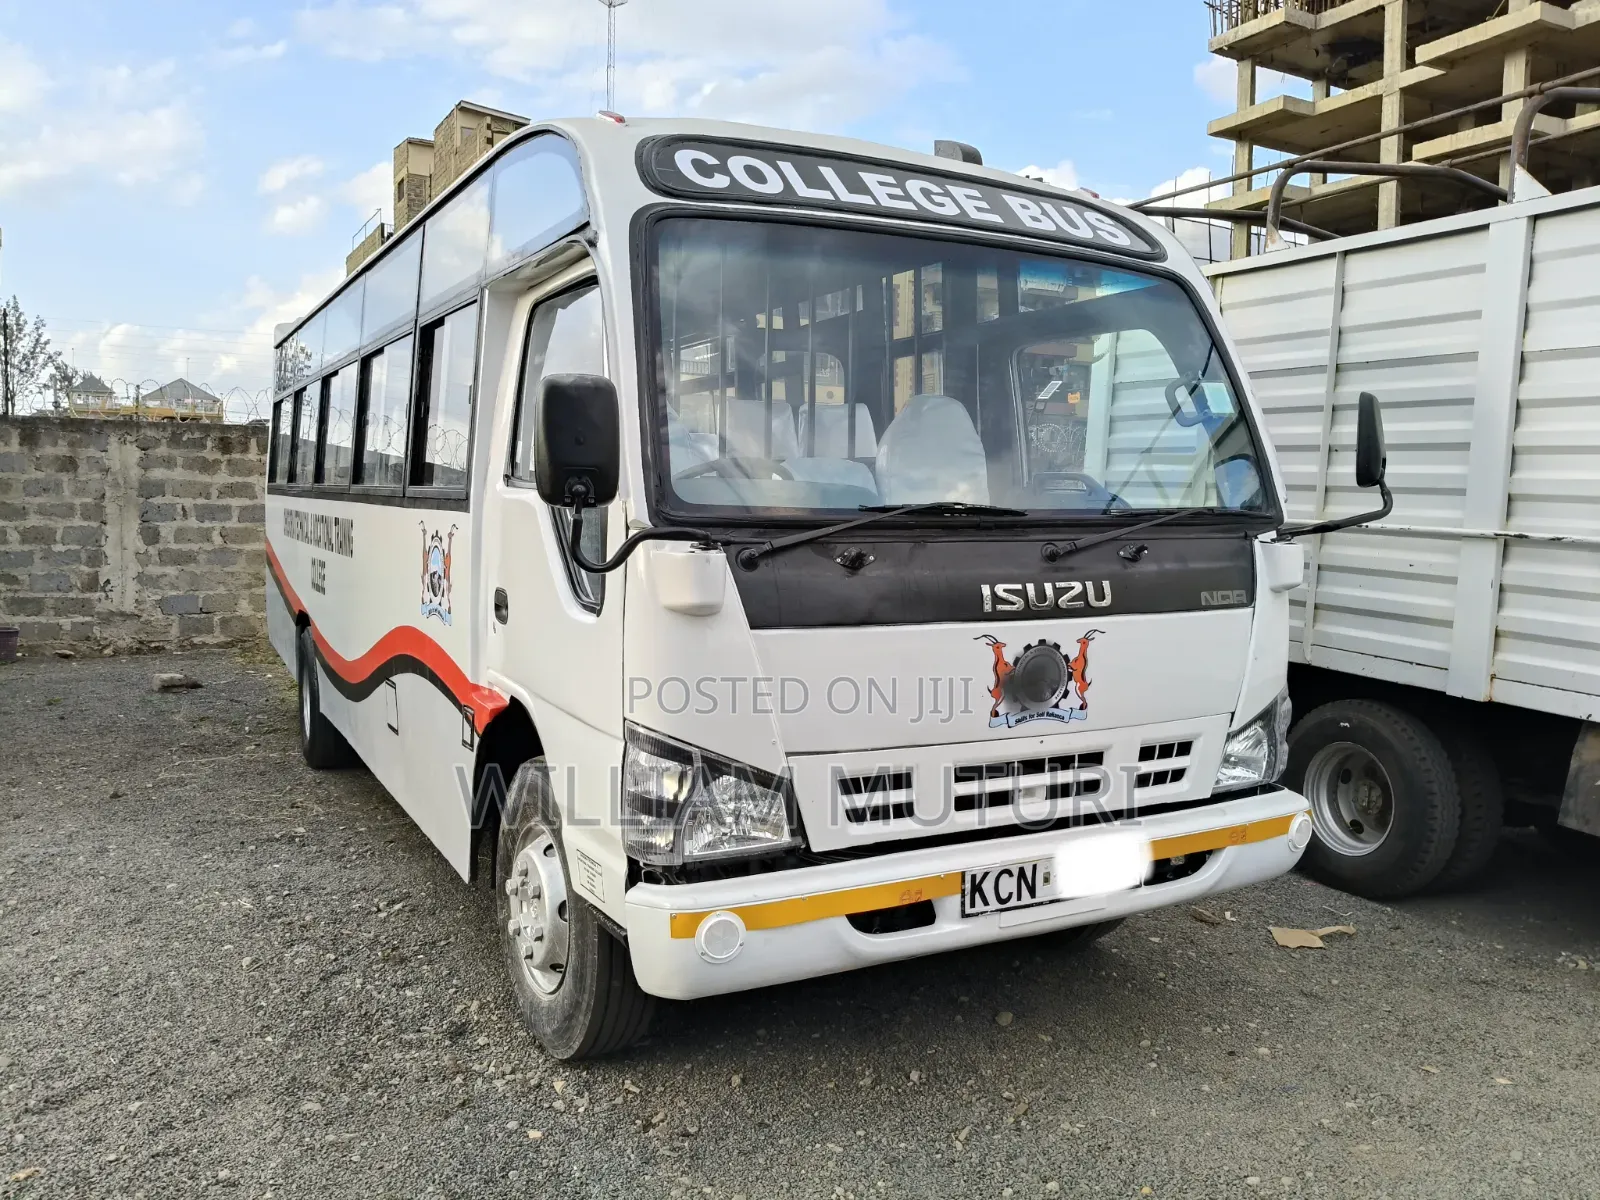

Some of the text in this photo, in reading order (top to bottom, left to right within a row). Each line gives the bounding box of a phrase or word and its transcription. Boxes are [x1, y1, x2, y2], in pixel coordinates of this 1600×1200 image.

[674, 149, 1132, 247] COLLEGE BUS
[980, 580, 1112, 613] ISUZU
[969, 864, 1037, 909] KCN
